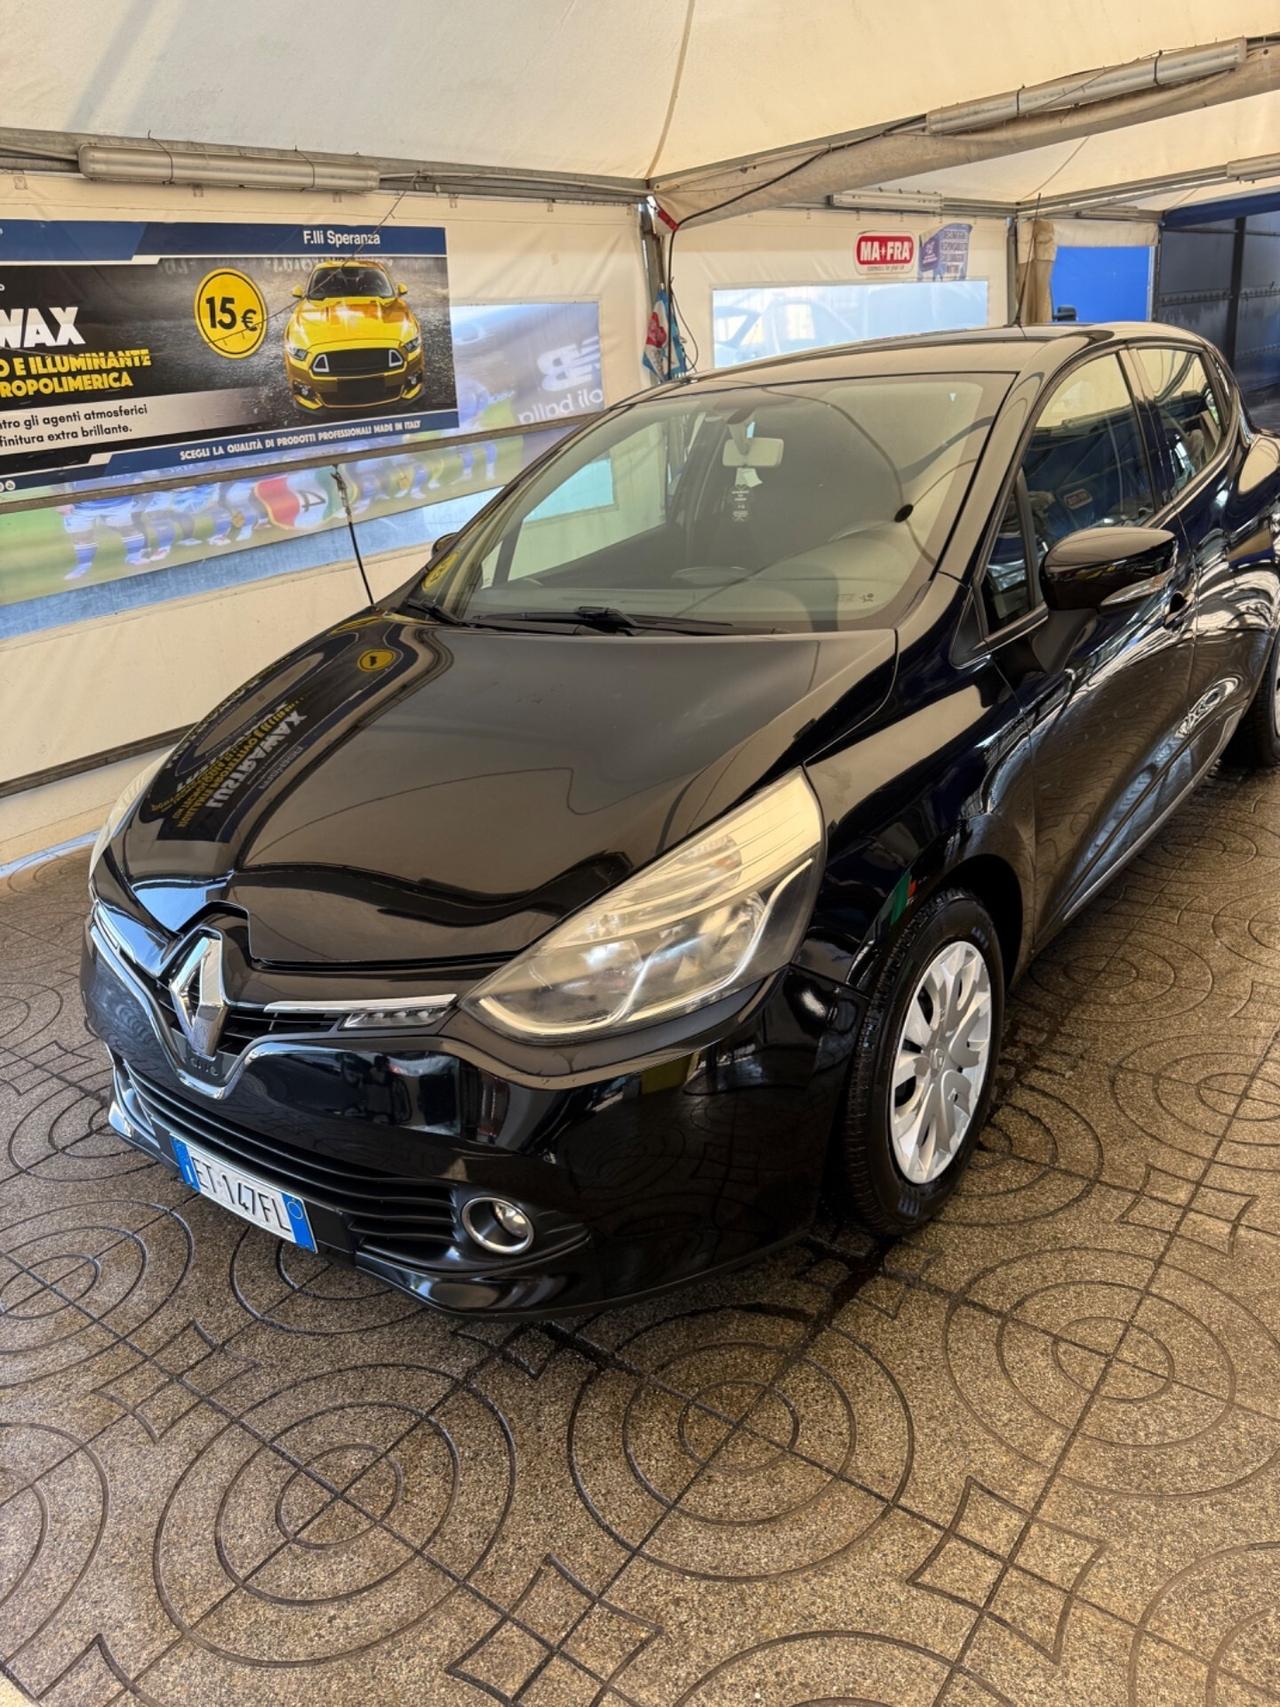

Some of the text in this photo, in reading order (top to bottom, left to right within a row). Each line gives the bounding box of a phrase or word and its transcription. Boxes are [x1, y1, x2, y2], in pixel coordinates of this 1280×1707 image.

[327, 231, 380, 247] Speranza
[13, 357, 26, 376] E
[28, 348, 152, 376] ILLUMINANTE
[0, 371, 134, 398] ROPOLIMERICA
[24, 414, 39, 430] gli
[42, 411, 81, 427] agenti
[84, 404, 148, 420] atmosferici
[47, 430, 78, 442] extra
[81, 424, 132, 438] brillante.
[179, 420, 422, 461] SCEGLI LA QUALITÀ DI PRODOTTI PROFESSIONALI MADE IN ITALY
